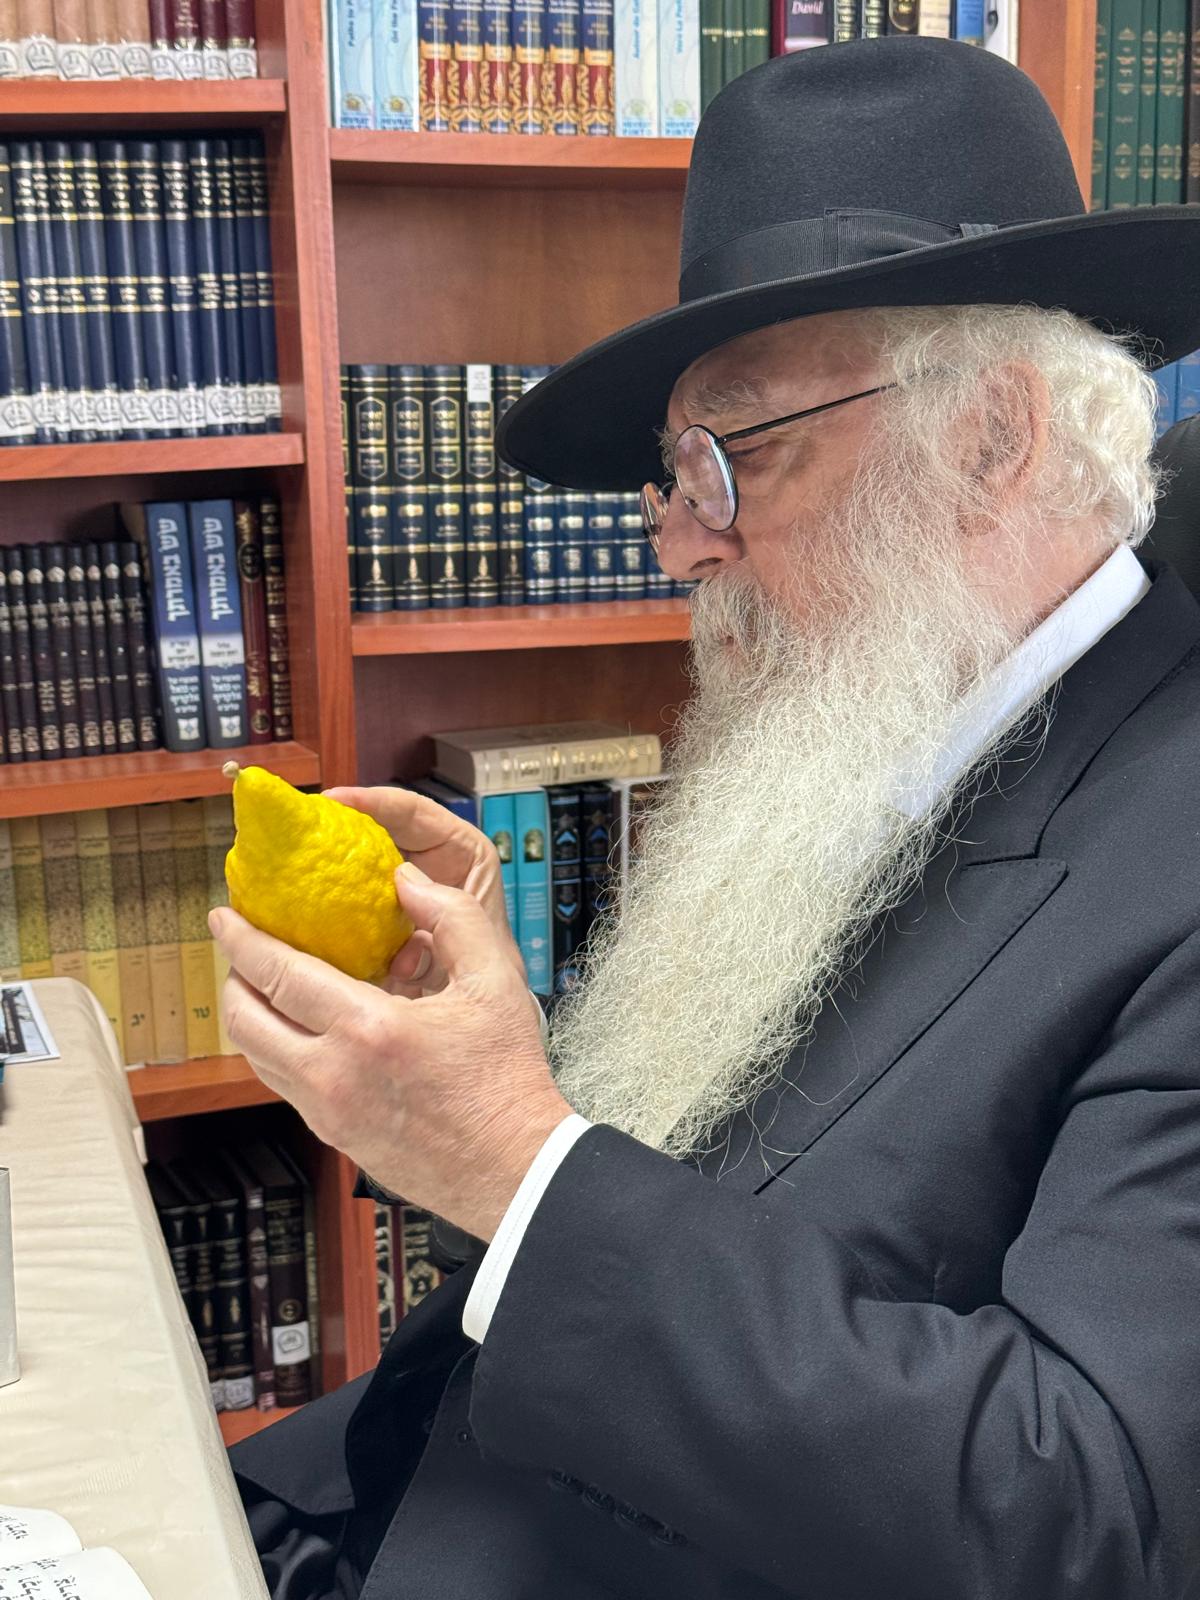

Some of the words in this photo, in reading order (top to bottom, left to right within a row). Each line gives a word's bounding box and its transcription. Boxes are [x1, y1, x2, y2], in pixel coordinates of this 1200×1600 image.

[157, 517, 179, 552] שש
[203, 516, 224, 550] שש
[162, 553, 191, 622] באמרתך
[208, 553, 235, 621] באמרתך
